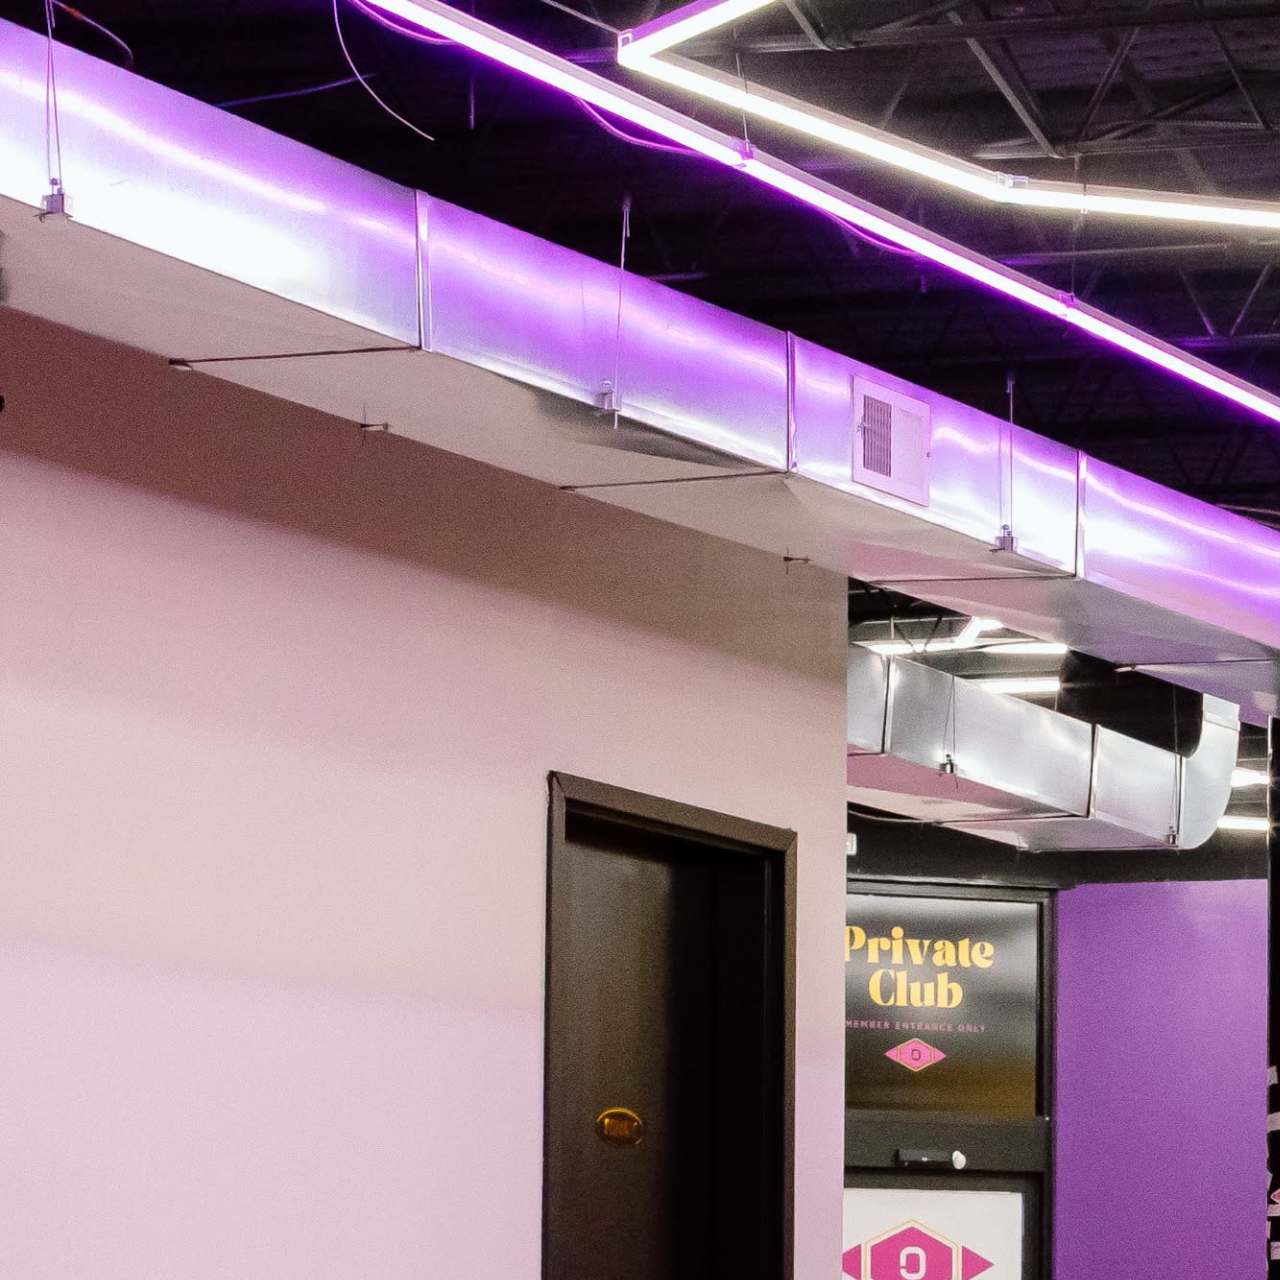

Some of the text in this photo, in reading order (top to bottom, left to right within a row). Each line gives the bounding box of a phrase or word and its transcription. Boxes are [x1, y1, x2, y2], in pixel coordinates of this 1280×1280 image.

[845, 926, 995, 968] Private
[868, 968, 964, 1009] Club
[895, 1021, 953, 1032] ENTRANCE
[958, 1023, 985, 1033] ONLY
